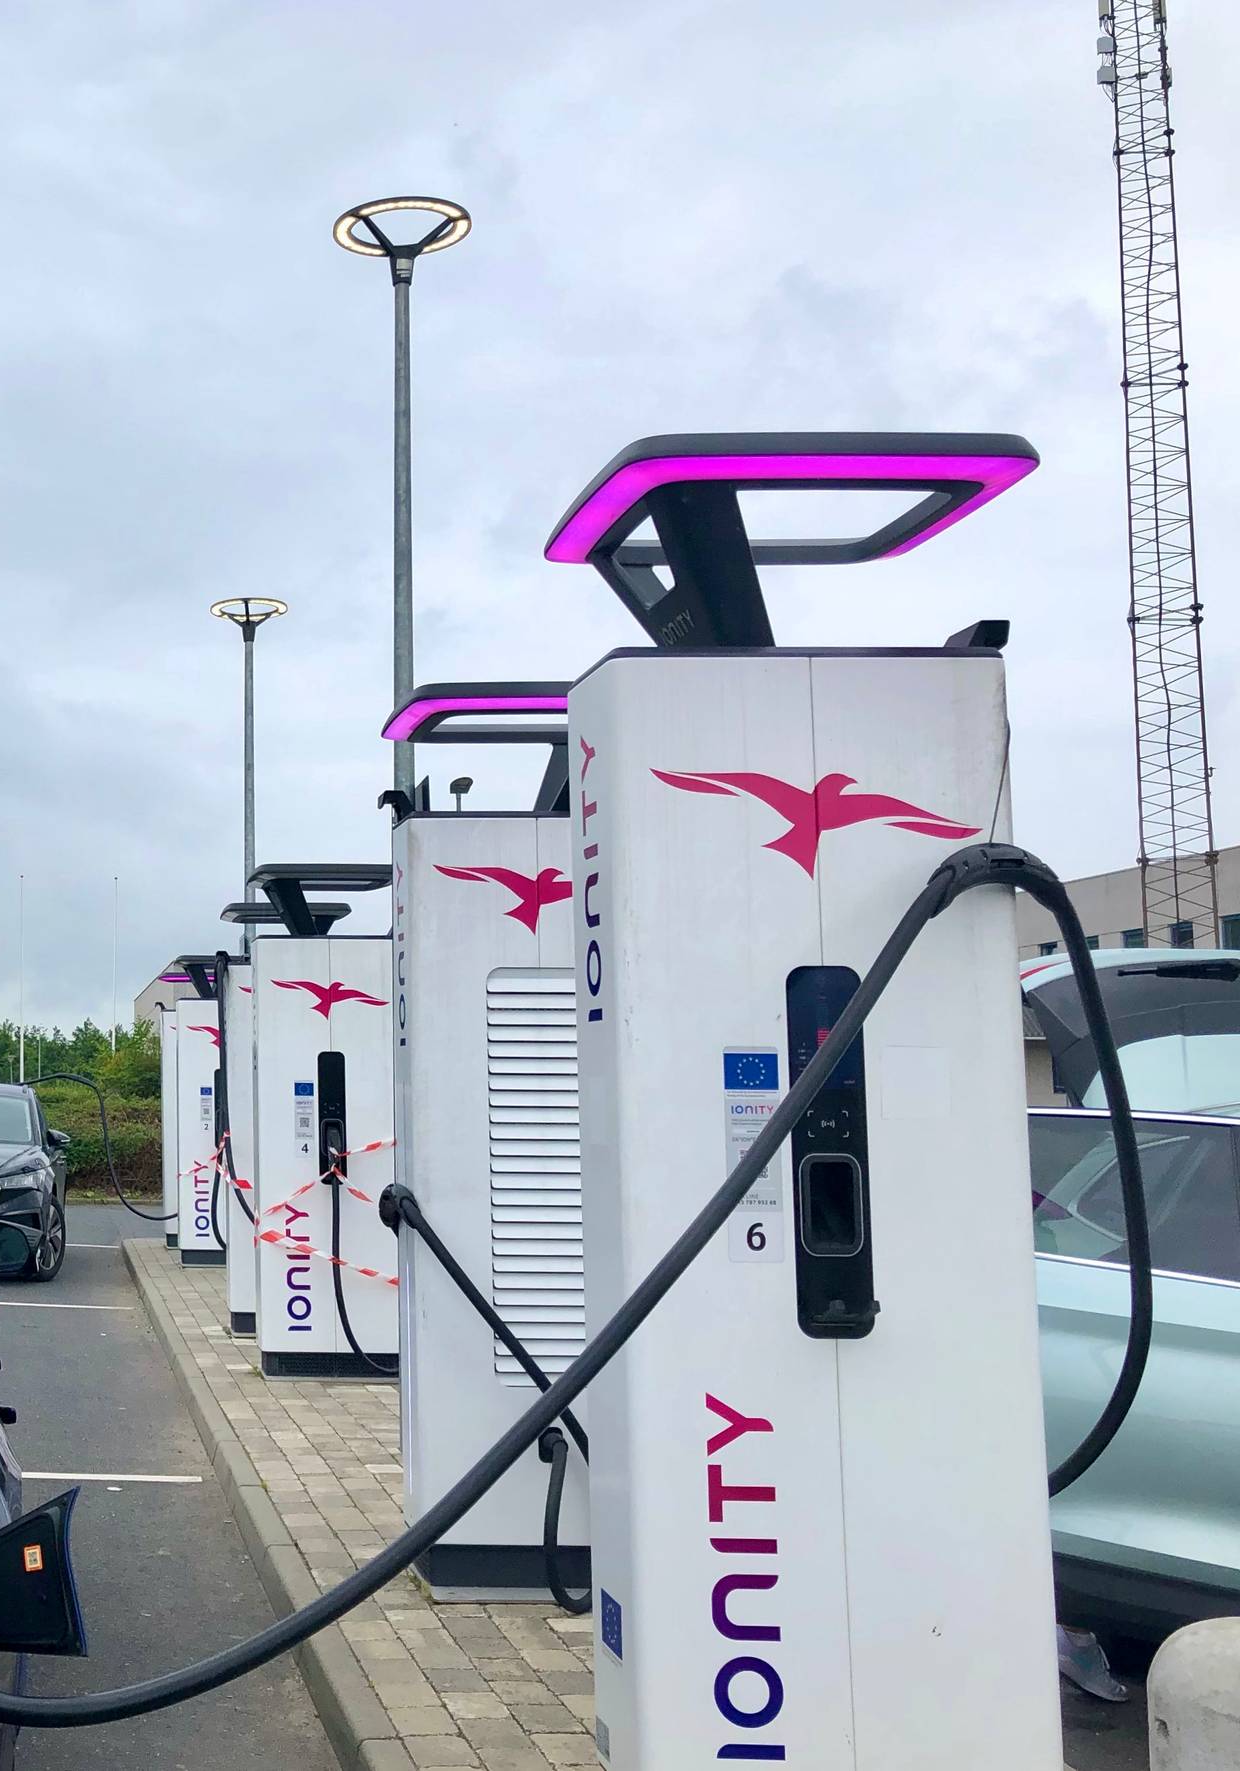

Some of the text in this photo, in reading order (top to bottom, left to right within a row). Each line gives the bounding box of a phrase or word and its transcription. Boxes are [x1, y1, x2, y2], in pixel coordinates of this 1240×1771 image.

[580, 735, 603, 1022] IONITY
[396, 861, 407, 1046] IONITY
[301, 1143, 309, 1153] 4
[731, 1105, 774, 1114] IONITY
[194, 1160, 210, 1237] IONITY
[746, 1222, 766, 1251] 6
[285, 1203, 312, 1332] IONITY
[705, 1392, 786, 1761] IONITY
